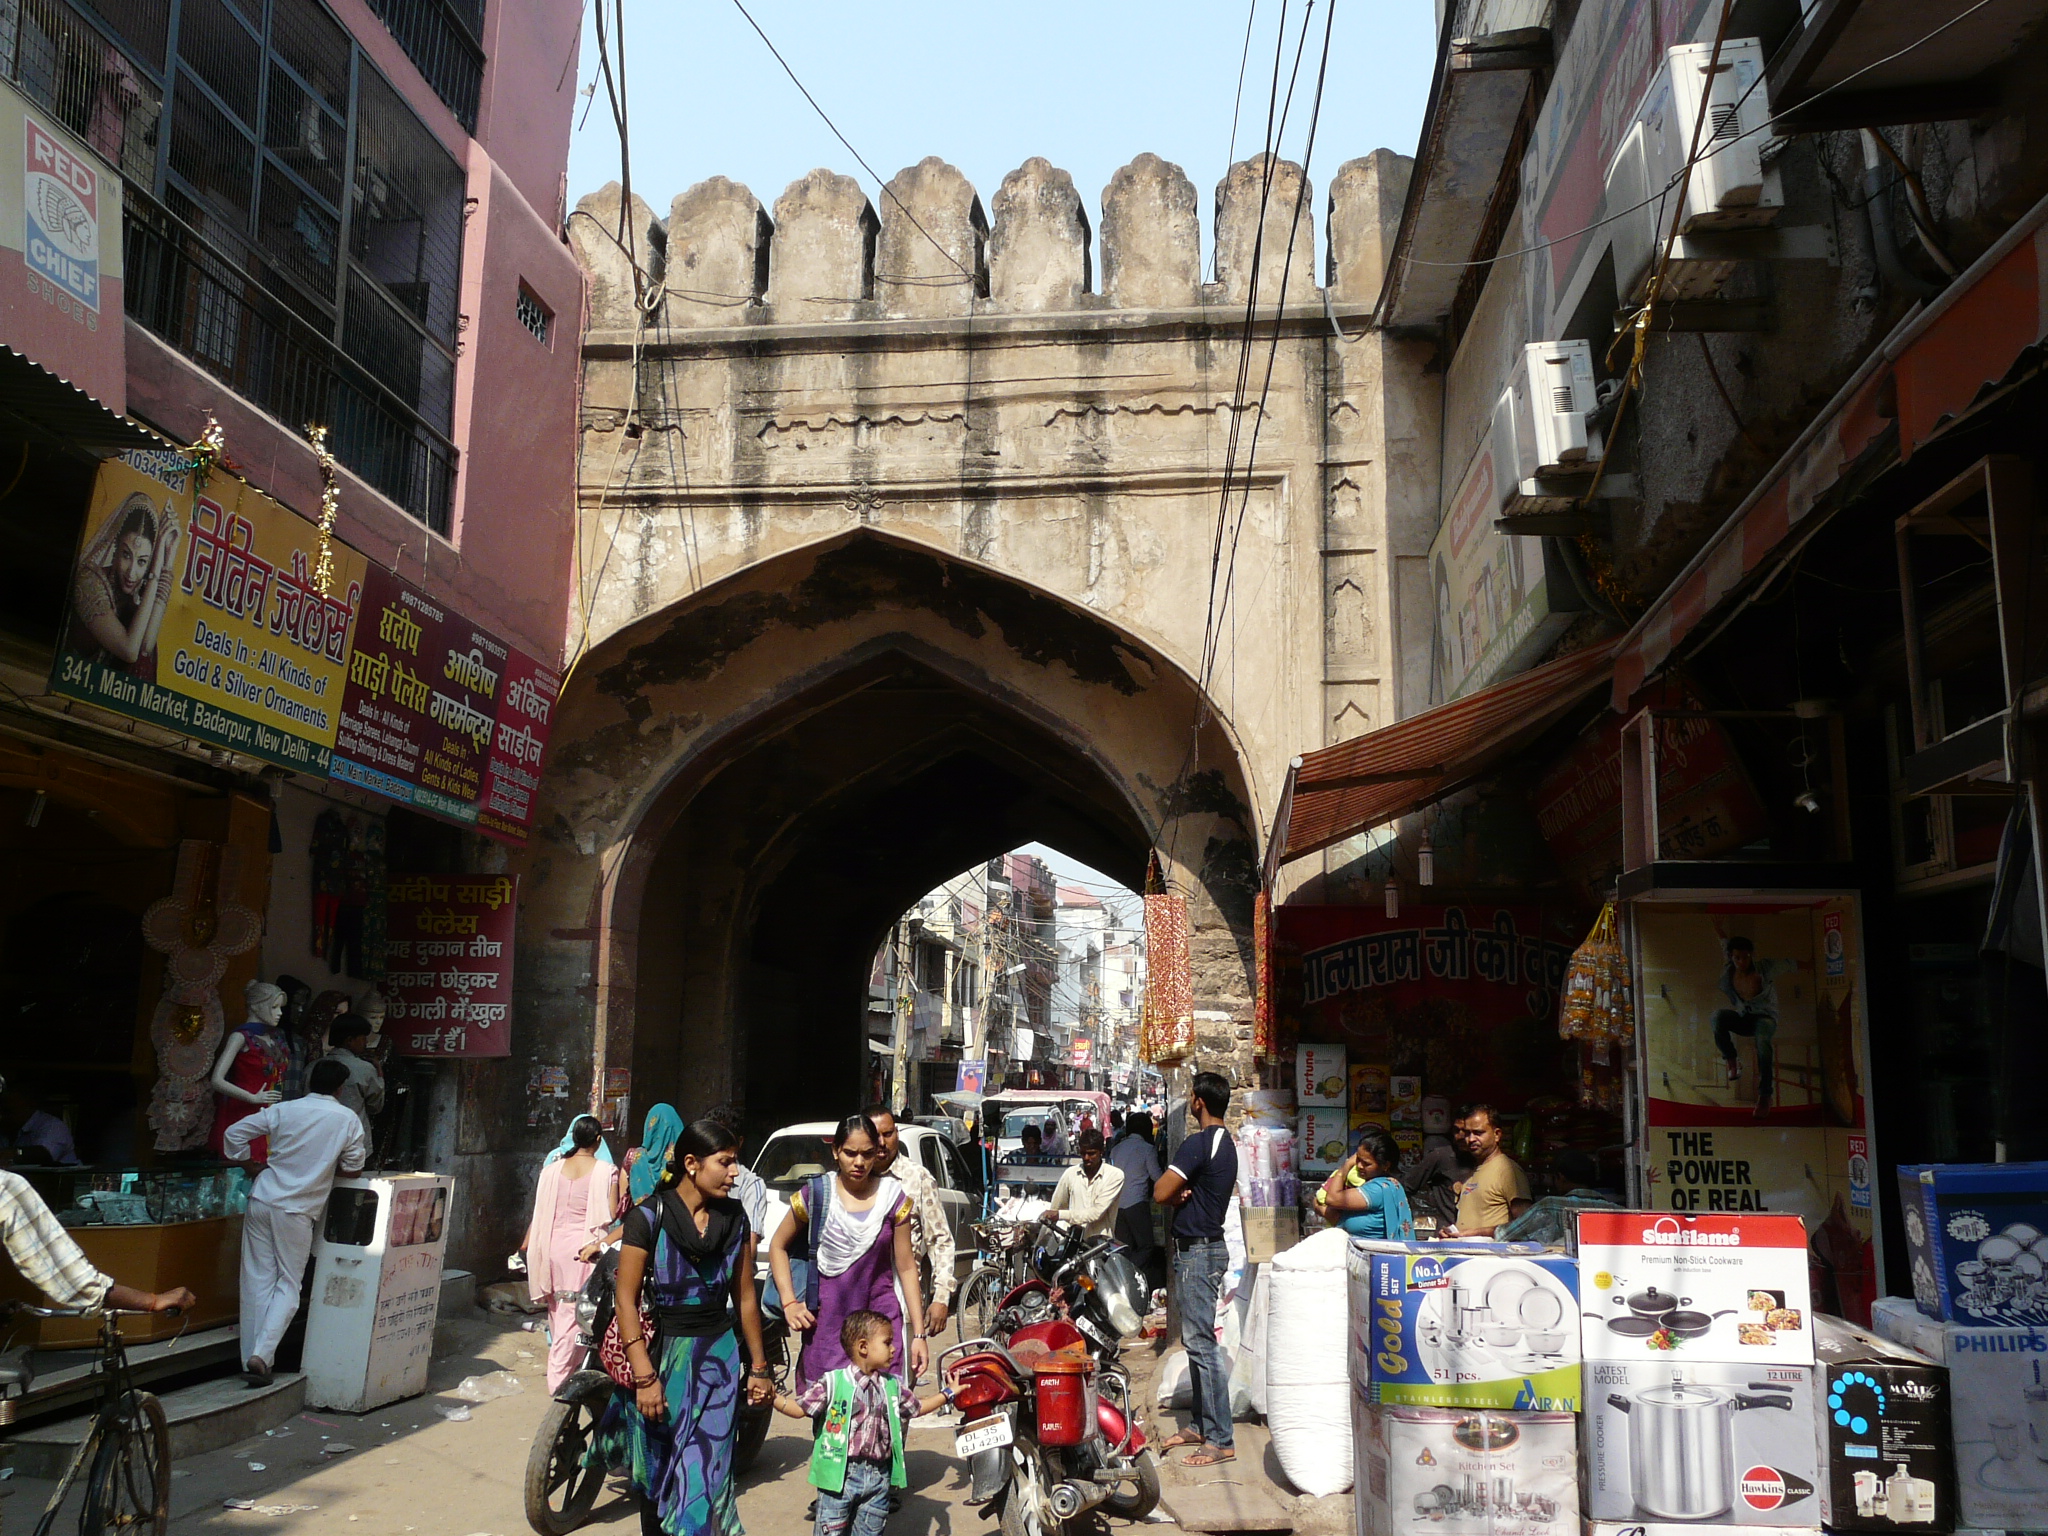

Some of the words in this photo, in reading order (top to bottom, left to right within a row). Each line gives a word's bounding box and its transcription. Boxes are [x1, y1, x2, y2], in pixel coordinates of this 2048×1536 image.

[35, 132, 92, 196] RED
[30, 238, 96, 297] CHIEF
[26, 272, 98, 332] SHOES
[181, 496, 274, 625] नितिन
[379, 600, 423, 657] संदीप
[194, 621, 233, 660] Deals
[234, 637, 248, 662] In
[258, 650, 276, 678] All
[277, 657, 312, 692] Kinds
[314, 675, 328, 698] of
[350, 648, 392, 701] साड़ी
[391, 659, 430, 715] पैलेस
[444, 648, 499, 700] आशिष
[173, 650, 208, 685] Gold
[211, 666, 222, 690] &
[224, 668, 262, 706] Silver
[264, 687, 330, 732] Ornaments.
[506, 678, 551, 727] अंकित
[62, 656, 95, 692] 341,
[99, 668, 138, 704] Main
[139, 684, 190, 723] Market,
[192, 704, 254, 748] Badarpur,
[254, 726, 281, 753] New
[282, 734, 311, 763] Delhi
[316, 748, 330, 771] 44
[442, 736, 460, 757] Deals
[424, 749, 435, 765] All
[434, 751, 452, 773] Kinds
[452, 761, 461, 775] of
[422, 767, 441, 788] Gents
[441, 775, 447, 790] &
[447, 776, 462, 796] Kids
[462, 782, 477, 801] Wear
[386, 876, 450, 903] संदीप
[456, 876, 512, 911] साड़ी
[416, 907, 479, 935] पैलेस
[1825, 916, 1839, 928] RED
[416, 940, 465, 965] दुकान
[469, 934, 502, 958] तीन
[1422, 906, 1470, 980] जी
[1474, 908, 1520, 985] की
[387, 972, 436, 996] दुकान
[410, 995, 447, 1020] गली
[471, 1002, 507, 1029] खुल
[411, 1026, 441, 1053] गई
[1304, 1050, 1314, 1096] Fortune
[1304, 1114, 1315, 1160] Fortune
[1394, 1133, 1420, 1141] CHOCOS
[1667, 1132, 1714, 1157] THE
[1849, 1140, 1865, 1153] RED
[1669, 1160, 1751, 1186] POWER
[1671, 1189, 1701, 1212] OF
[1708, 1188, 1768, 1212] REAL
[1851, 1191, 1872, 1207] CHIEF
[1642, 1227, 1740, 1246] Sunflame
[1415, 1264, 1441, 1278] No.1
[1641, 1255, 1672, 1264] Premium
[1673, 1256, 1706, 1265] Non-Stick
[1708, 1257, 1743, 1266] Cookware
[1381, 1263, 1389, 1296] DINNER
[1391, 1278, 1399, 1294] SET
[1418, 1279, 1438, 1289] Dinner
[1437, 1278, 1448, 1287] Set
[1377, 1298, 1408, 1375] Gold
[1955, 1335, 2047, 1352] PHILIPS
[1040, 1378, 1060, 1387] EARTH
[1434, 1369, 1450, 1380] 51
[1456, 1370, 1481, 1383] pcs.
[1594, 1366, 1627, 1375] LATEST
[1594, 1376, 1630, 1385] MODEL
[1767, 1371, 1778, 1379] 12
[1779, 1371, 1803, 1380] LITRE
[1395, 1395, 1462, 1405] STAINLESS
[1465, 1395, 1499, 1406] STEEL
[1528, 1396, 1574, 1411] AIRAN
[961, 1443, 976, 1455] BJ
[979, 1434, 1007, 1448] 4290
[965, 1431, 981, 1443] DL
[984, 1426, 998, 1437] 3S
[1499, 1462, 1515, 1472] Set
[1741, 1483, 1785, 1495] Hawkins
